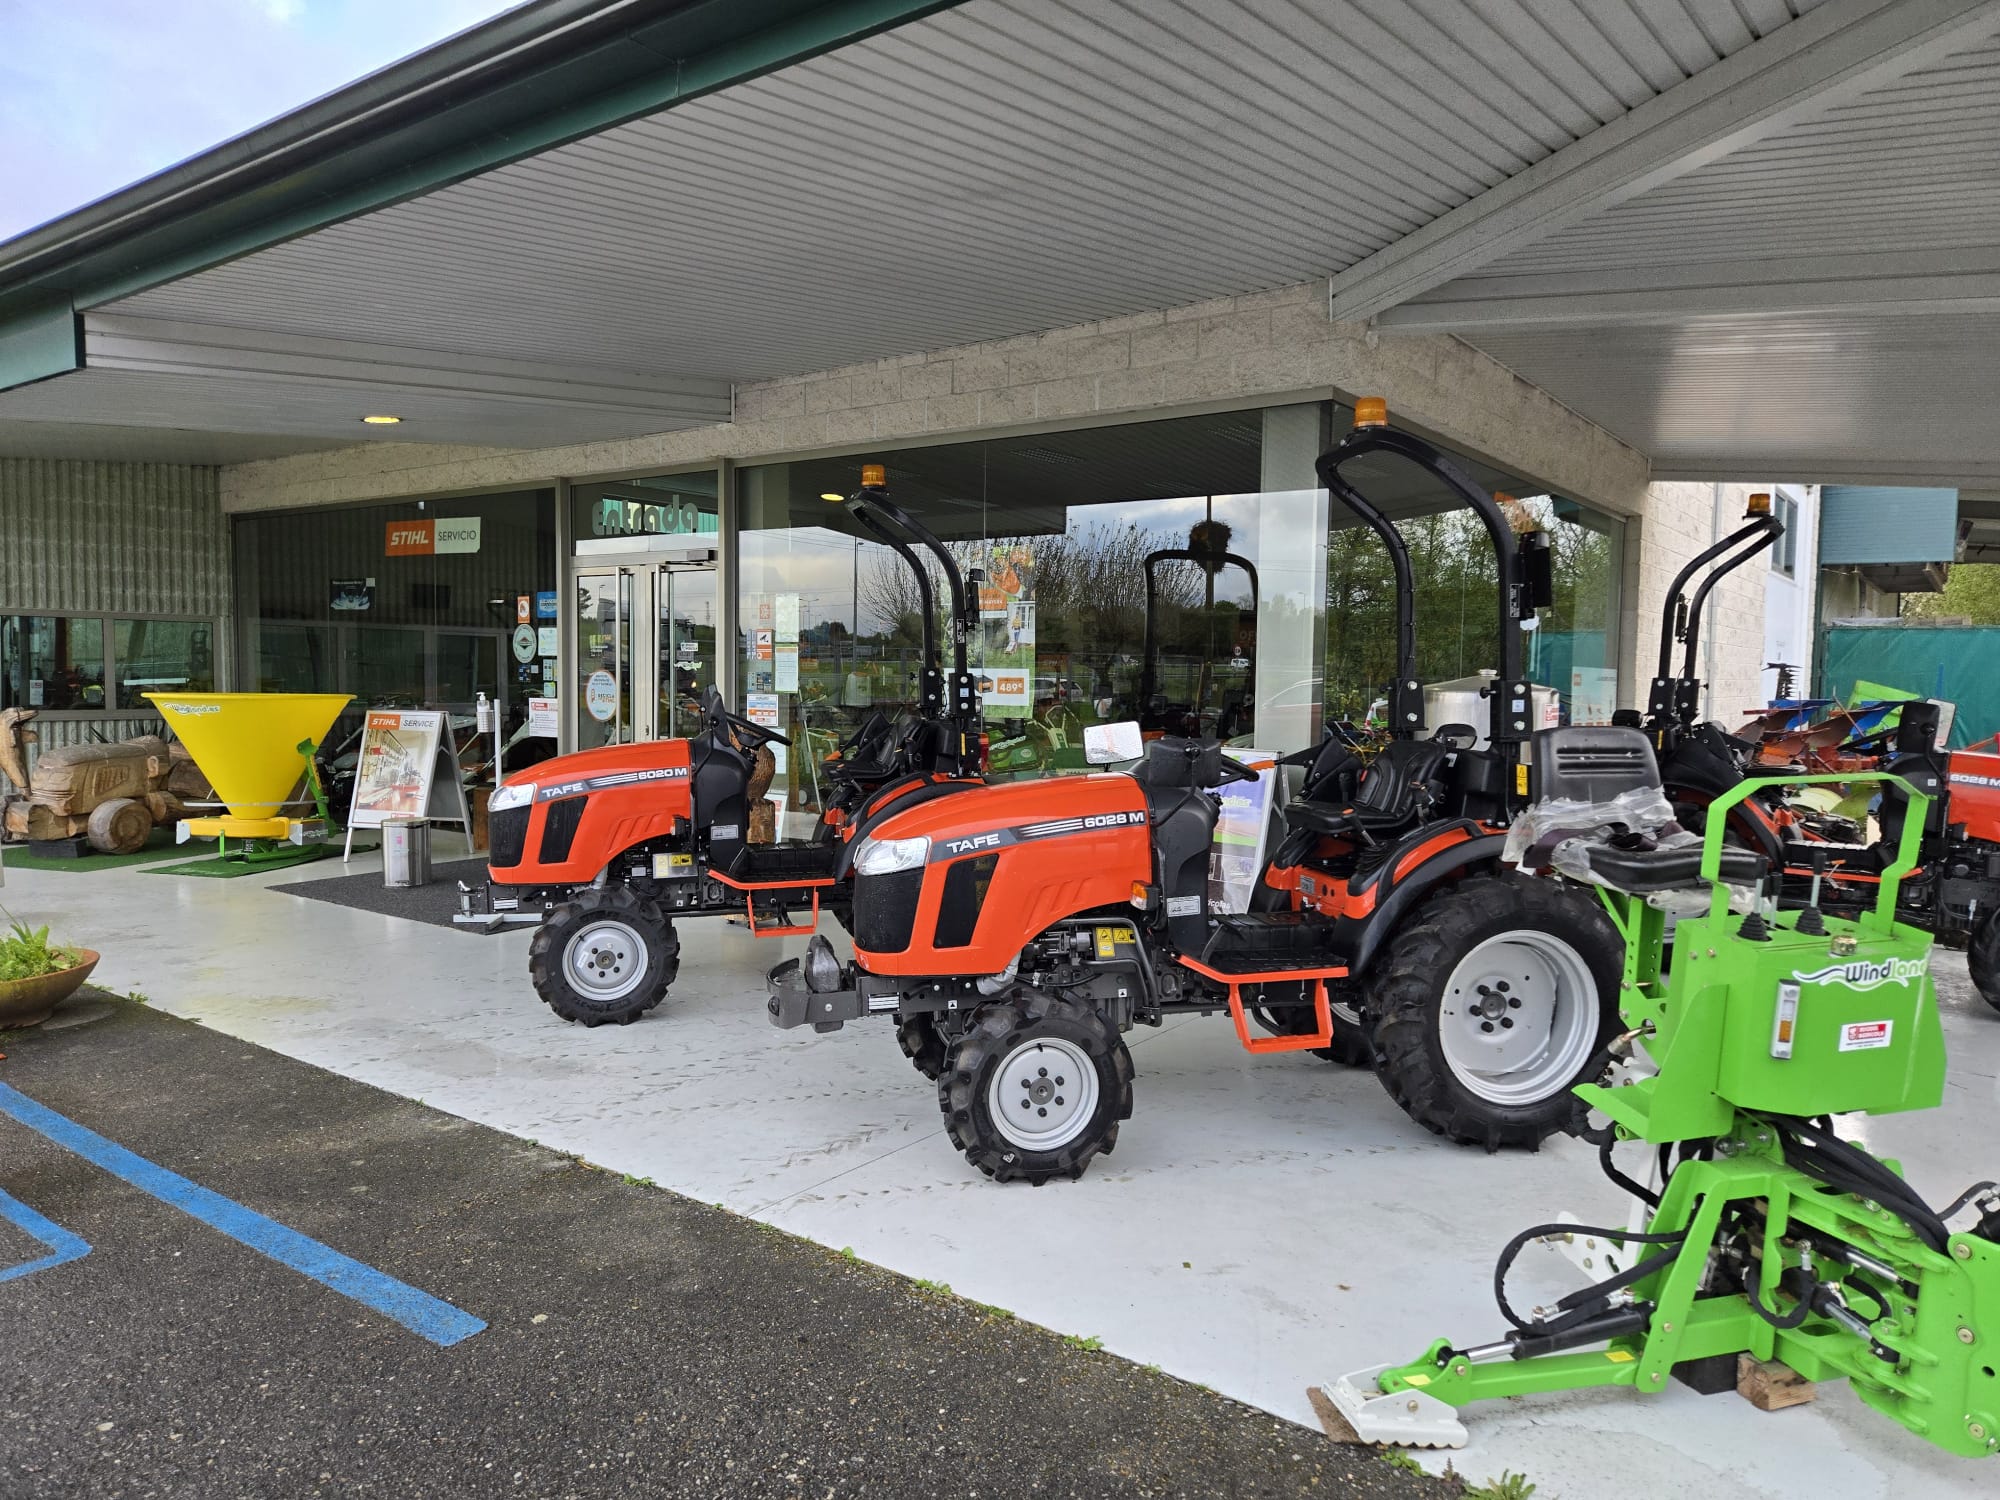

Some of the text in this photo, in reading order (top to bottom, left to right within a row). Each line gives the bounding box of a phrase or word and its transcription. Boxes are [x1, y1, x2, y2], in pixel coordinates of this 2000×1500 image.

[591, 494, 699, 536] Entrada
[390, 530, 477, 546] STIHL SERVICIO
[371, 717, 435, 728] STIHL SERVICE
[638, 767, 688, 780] 6020 M
[1950, 774, 1988, 785] 6028
[541, 782, 584, 798] TAFE
[1084, 812, 1145, 828] 6028 M
[946, 833, 1001, 853] TAFE
